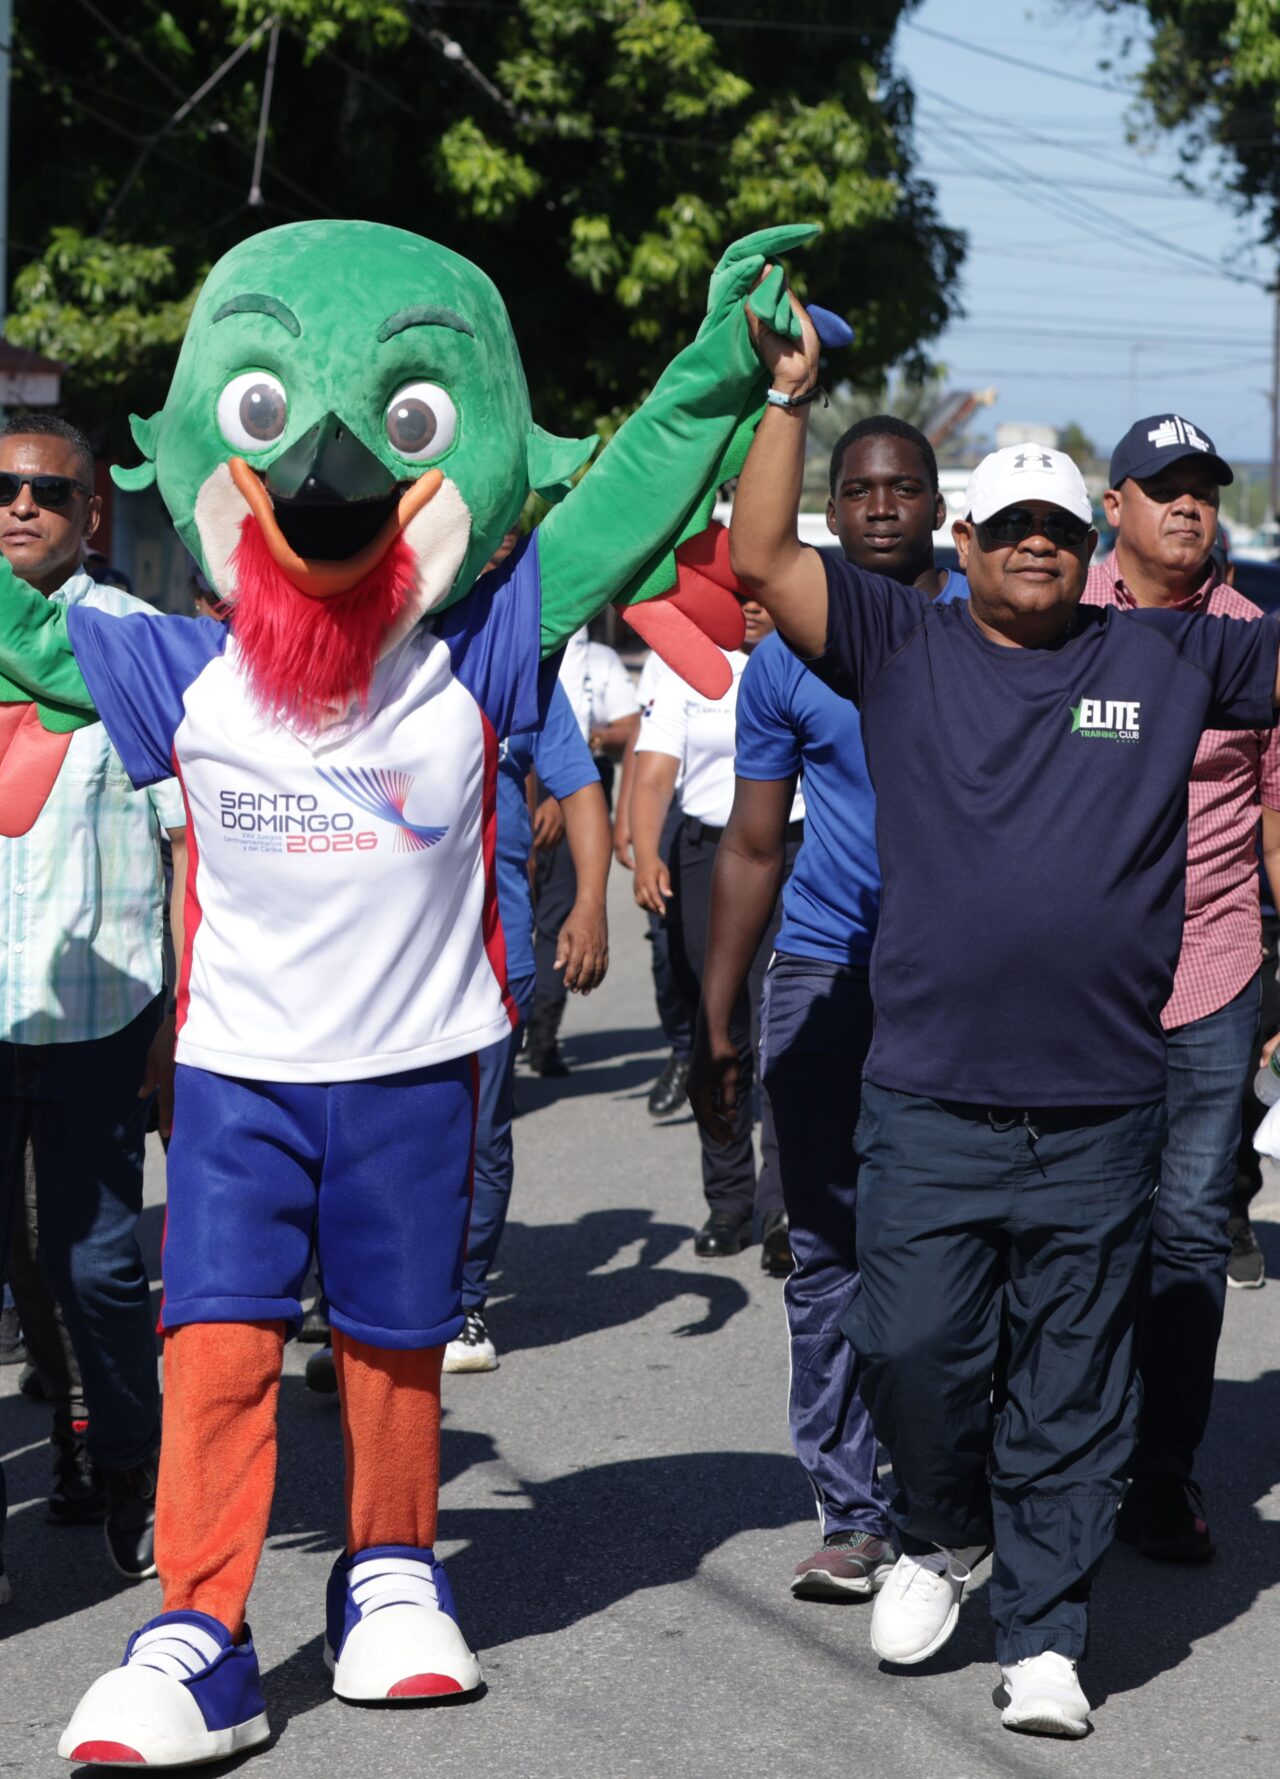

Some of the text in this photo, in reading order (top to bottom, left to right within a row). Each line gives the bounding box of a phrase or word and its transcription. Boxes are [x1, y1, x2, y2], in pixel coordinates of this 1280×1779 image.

[1080, 699, 1140, 730] ELITE
[1080, 730, 1140, 739] TRAINING CLUB
[220, 790, 318, 811] SANTO
[221, 810, 354, 833] DOMINGO
[286, 831, 378, 853] 2026
